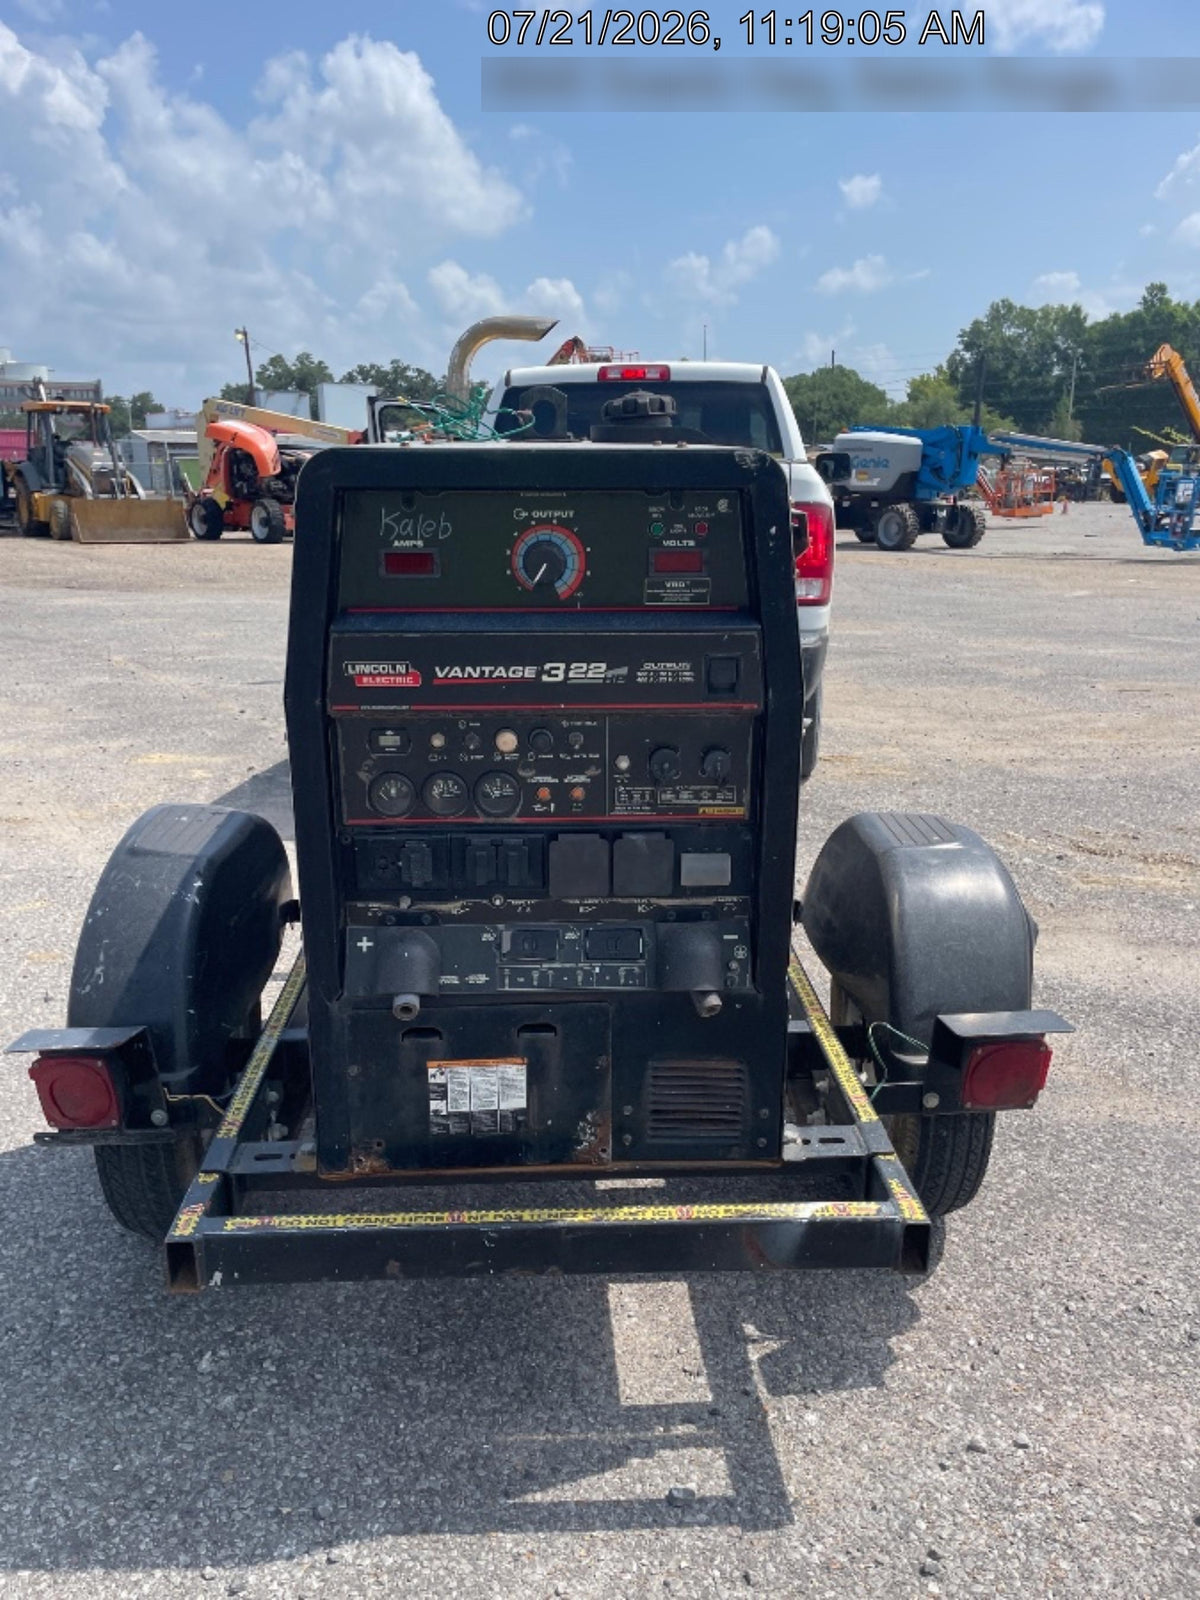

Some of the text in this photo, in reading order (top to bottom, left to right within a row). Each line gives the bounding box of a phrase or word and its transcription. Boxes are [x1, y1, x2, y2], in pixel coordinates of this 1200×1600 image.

[850, 455, 890, 469] Genie
[531, 509, 575, 518] OUTPUT
[379, 507, 453, 541] Kaleb
[392, 539, 424, 548] AMPS
[662, 539, 696, 547] VOLTS
[347, 662, 407, 675] LINCOLN
[434, 665, 538, 679] VANTAGE
[541, 662, 607, 683] 322
[361, 676, 415, 685] ELECTRIC
[343, 1215, 398, 1226] STAND
